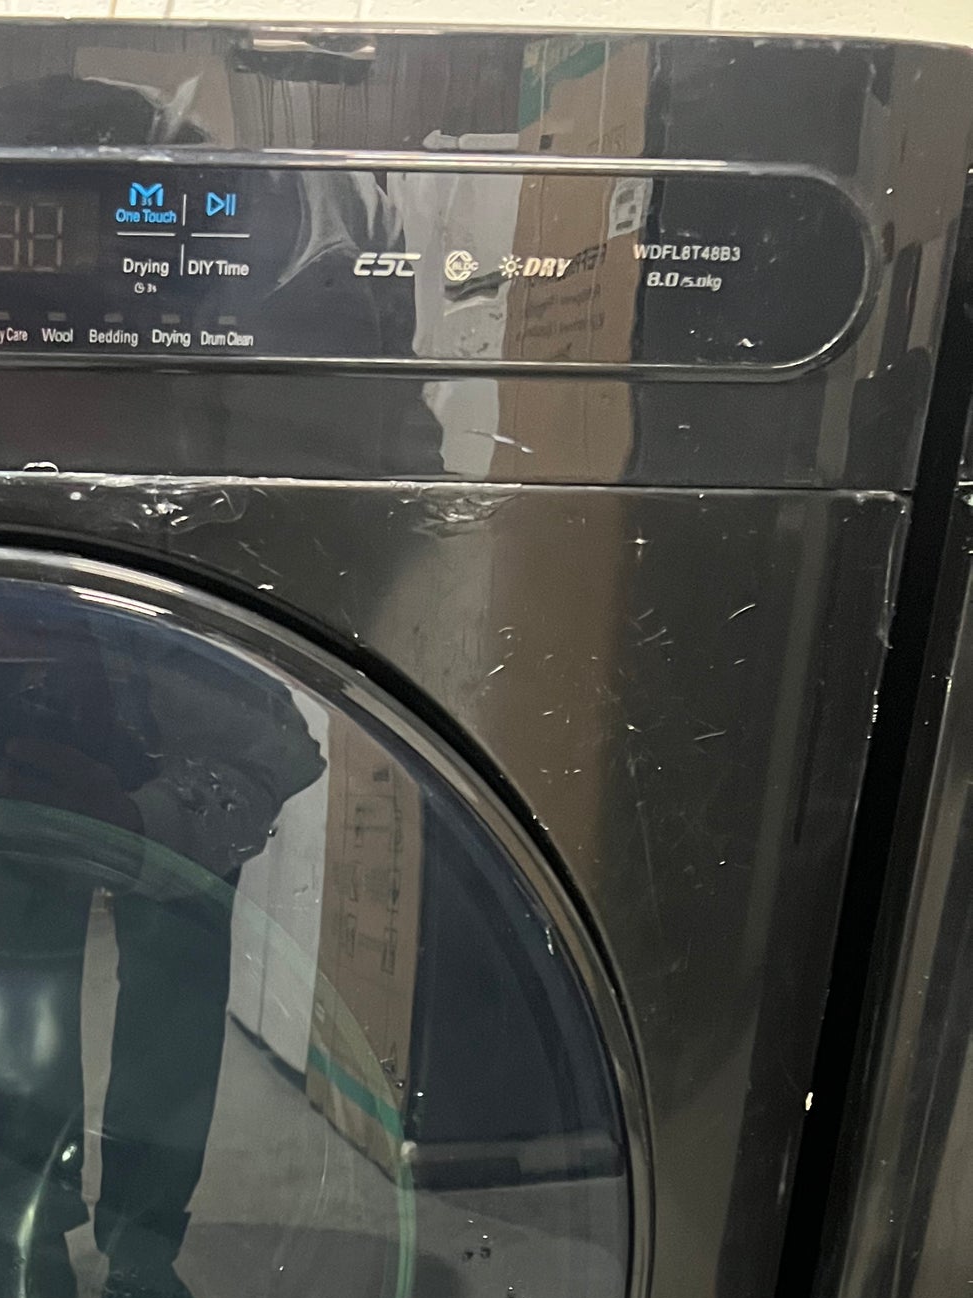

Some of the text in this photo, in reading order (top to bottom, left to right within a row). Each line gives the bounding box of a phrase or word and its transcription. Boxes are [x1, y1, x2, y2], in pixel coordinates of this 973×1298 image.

[116, 208, 177, 224] One Touch
[633, 244, 741, 261] WDFL8T48B3
[123, 257, 170, 277] Drying
[188, 261, 250, 276] DIY Time
[522, 257, 573, 278] DRY
[7, 328, 28, 342] Care
[42, 328, 74, 343] Wool
[89, 330, 139, 346] Bedding
[152, 330, 191, 348] Drying
[200, 331, 254, 347] Drum Clean
